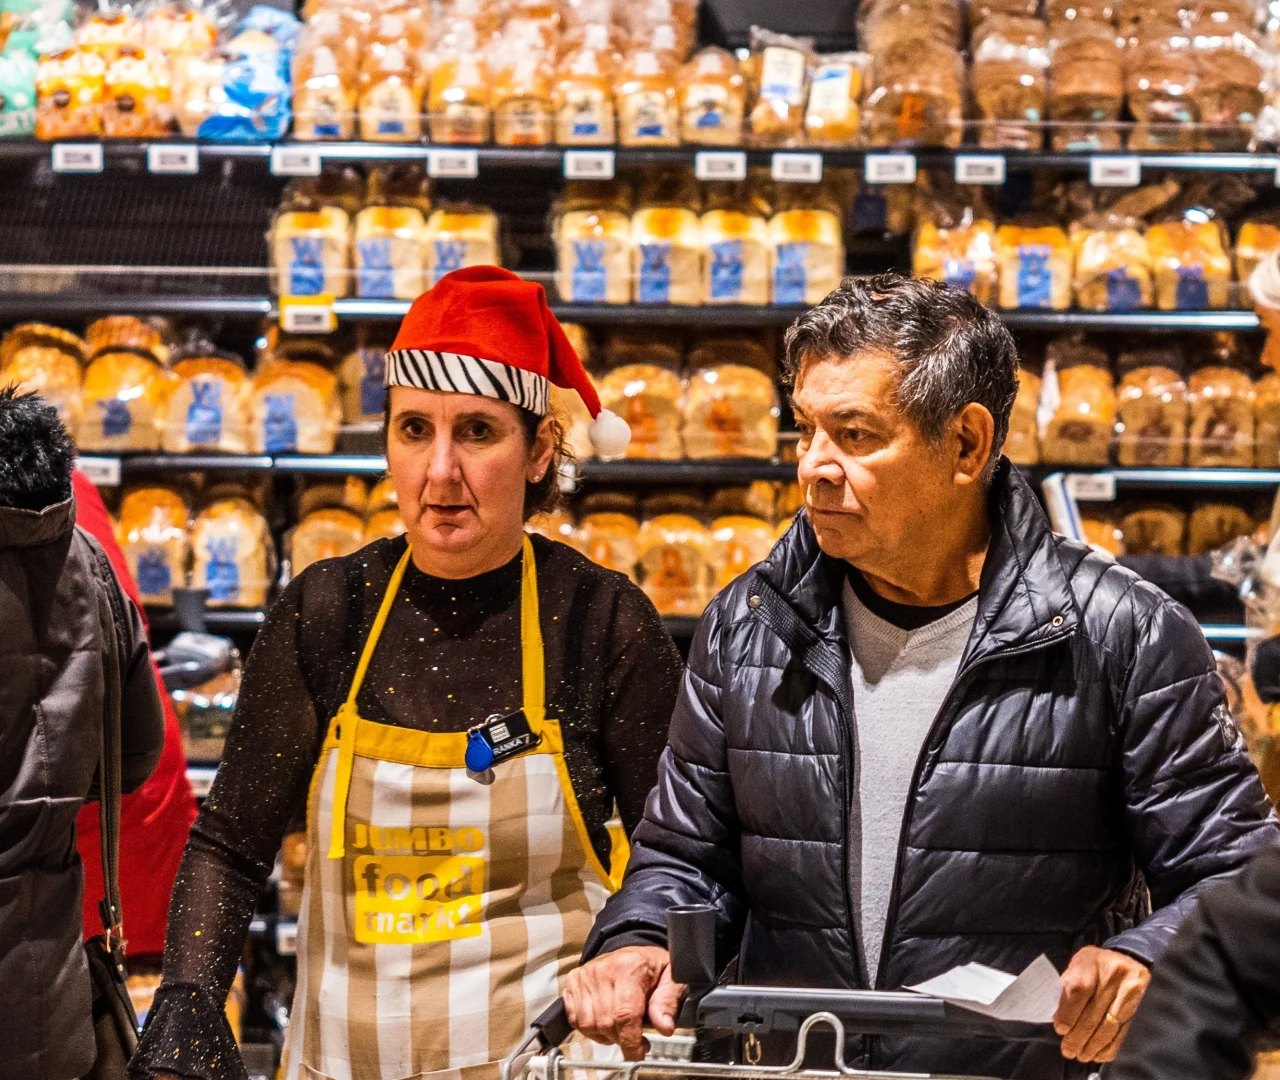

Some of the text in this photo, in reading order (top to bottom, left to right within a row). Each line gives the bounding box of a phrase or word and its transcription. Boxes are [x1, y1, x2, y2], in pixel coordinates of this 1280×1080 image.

[493, 738, 523, 755] RANKA
[352, 824, 486, 851] JUMBO
[362, 863, 473, 900] food
[364, 903, 473, 935] markt
